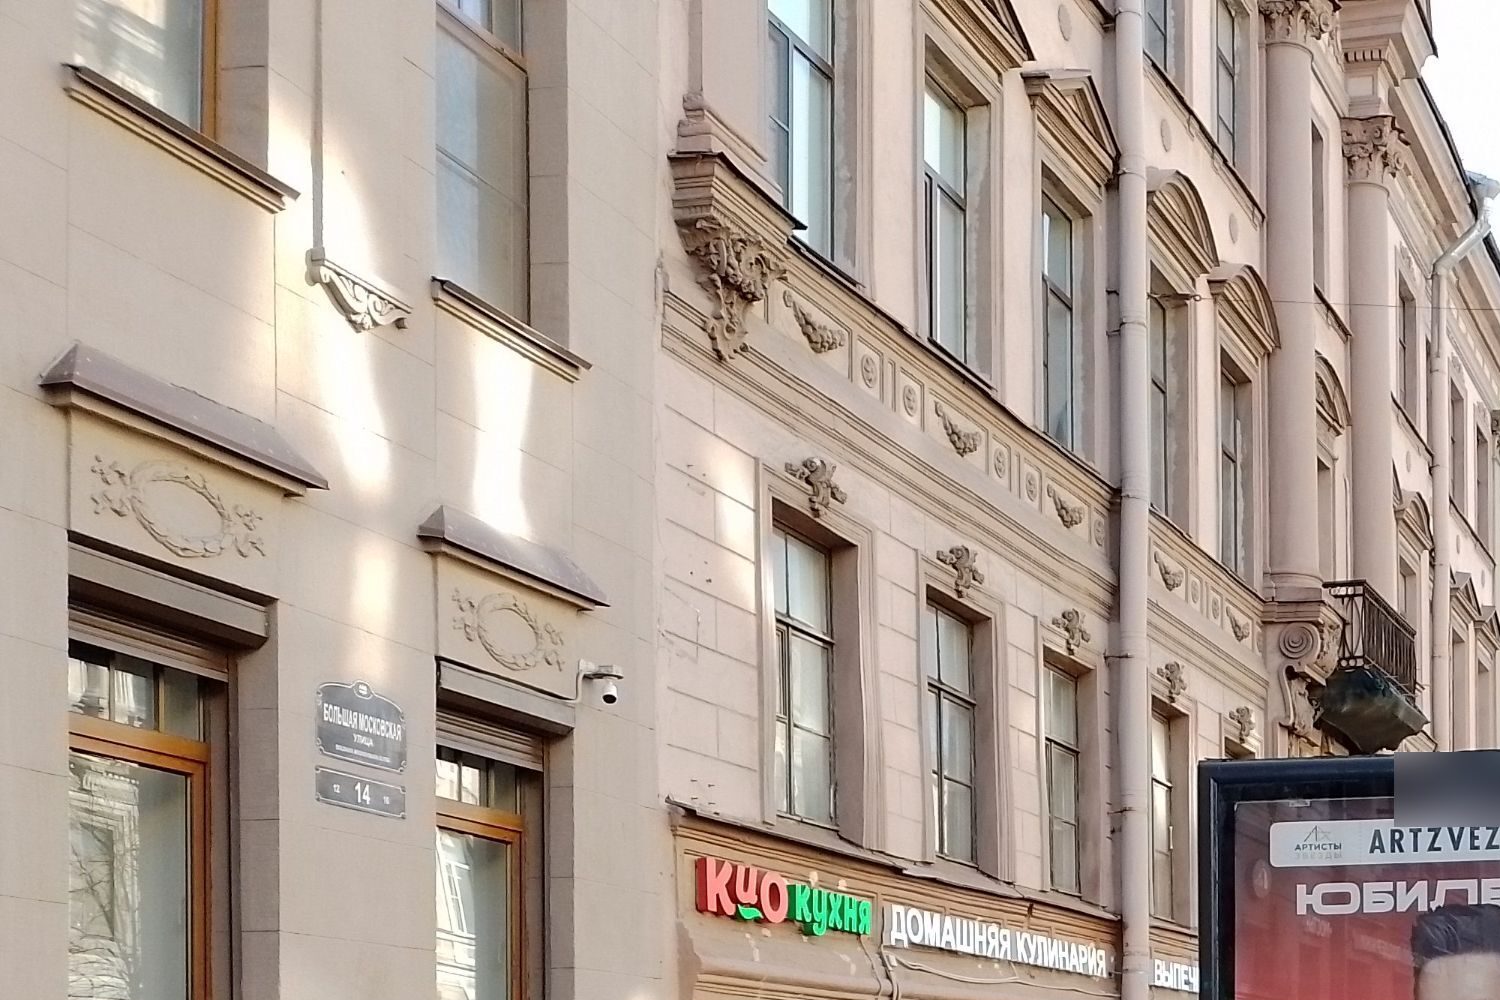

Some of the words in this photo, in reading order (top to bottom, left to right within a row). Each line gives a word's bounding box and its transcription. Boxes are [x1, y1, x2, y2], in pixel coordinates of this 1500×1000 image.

[323, 703, 358, 730] БОЛЬШАЯ
[358, 712, 402, 742] МОСКОВСКАЯ
[352, 733, 374, 747] УЛИЦА
[355, 782, 371, 805] 14
[1294, 843, 1342, 851] АРТИСТЫ
[890, 904, 1011, 961] ДОМАШНЯЯ
[1015, 931, 1107, 979] КУЛИНАРИЯ
